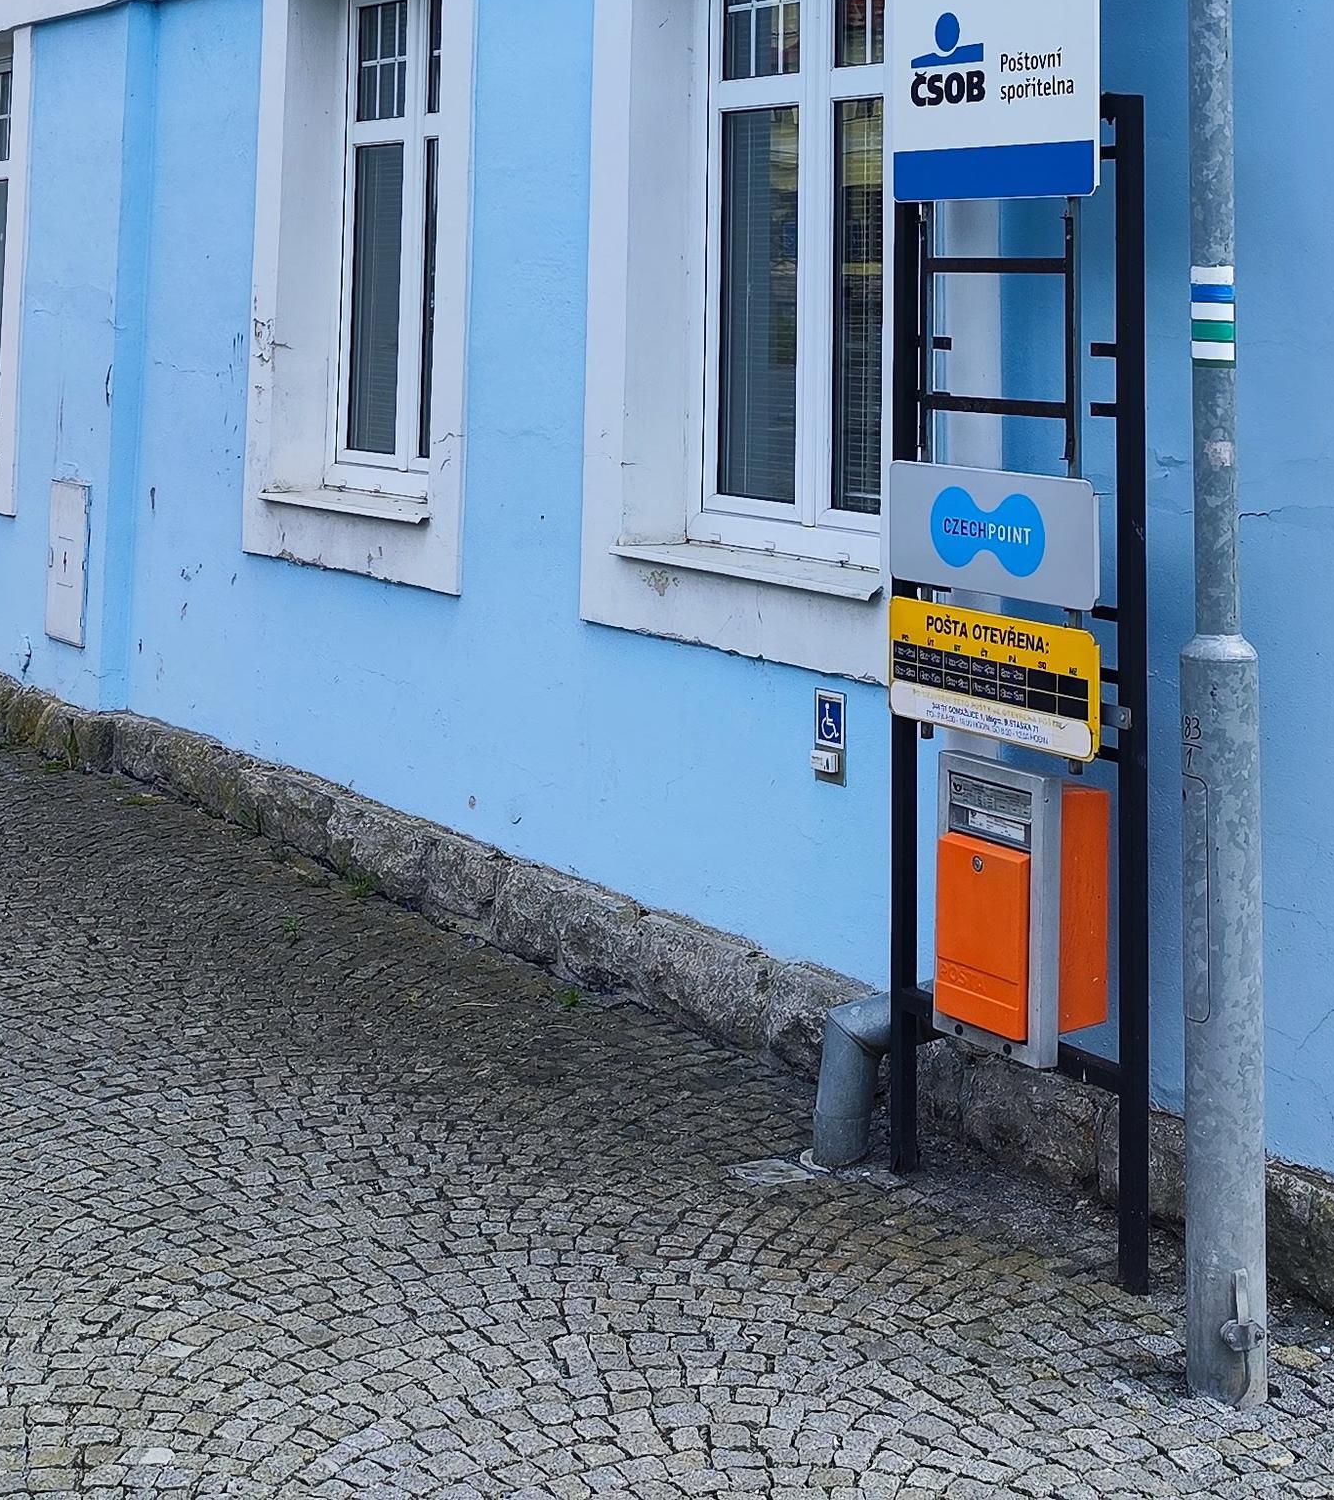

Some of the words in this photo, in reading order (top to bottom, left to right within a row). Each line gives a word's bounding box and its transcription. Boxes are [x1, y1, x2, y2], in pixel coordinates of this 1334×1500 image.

[1000, 46, 1063, 74] Poštovní
[910, 69, 987, 108] ČSOB
[1000, 74, 1075, 104] spořitelna
[942, 516, 1032, 546] CZECHPOINT
[925, 613, 968, 638] POŠTA
[972, 624, 1051, 655] OTEVŘENA:
[1183, 715, 1202, 740] 83
